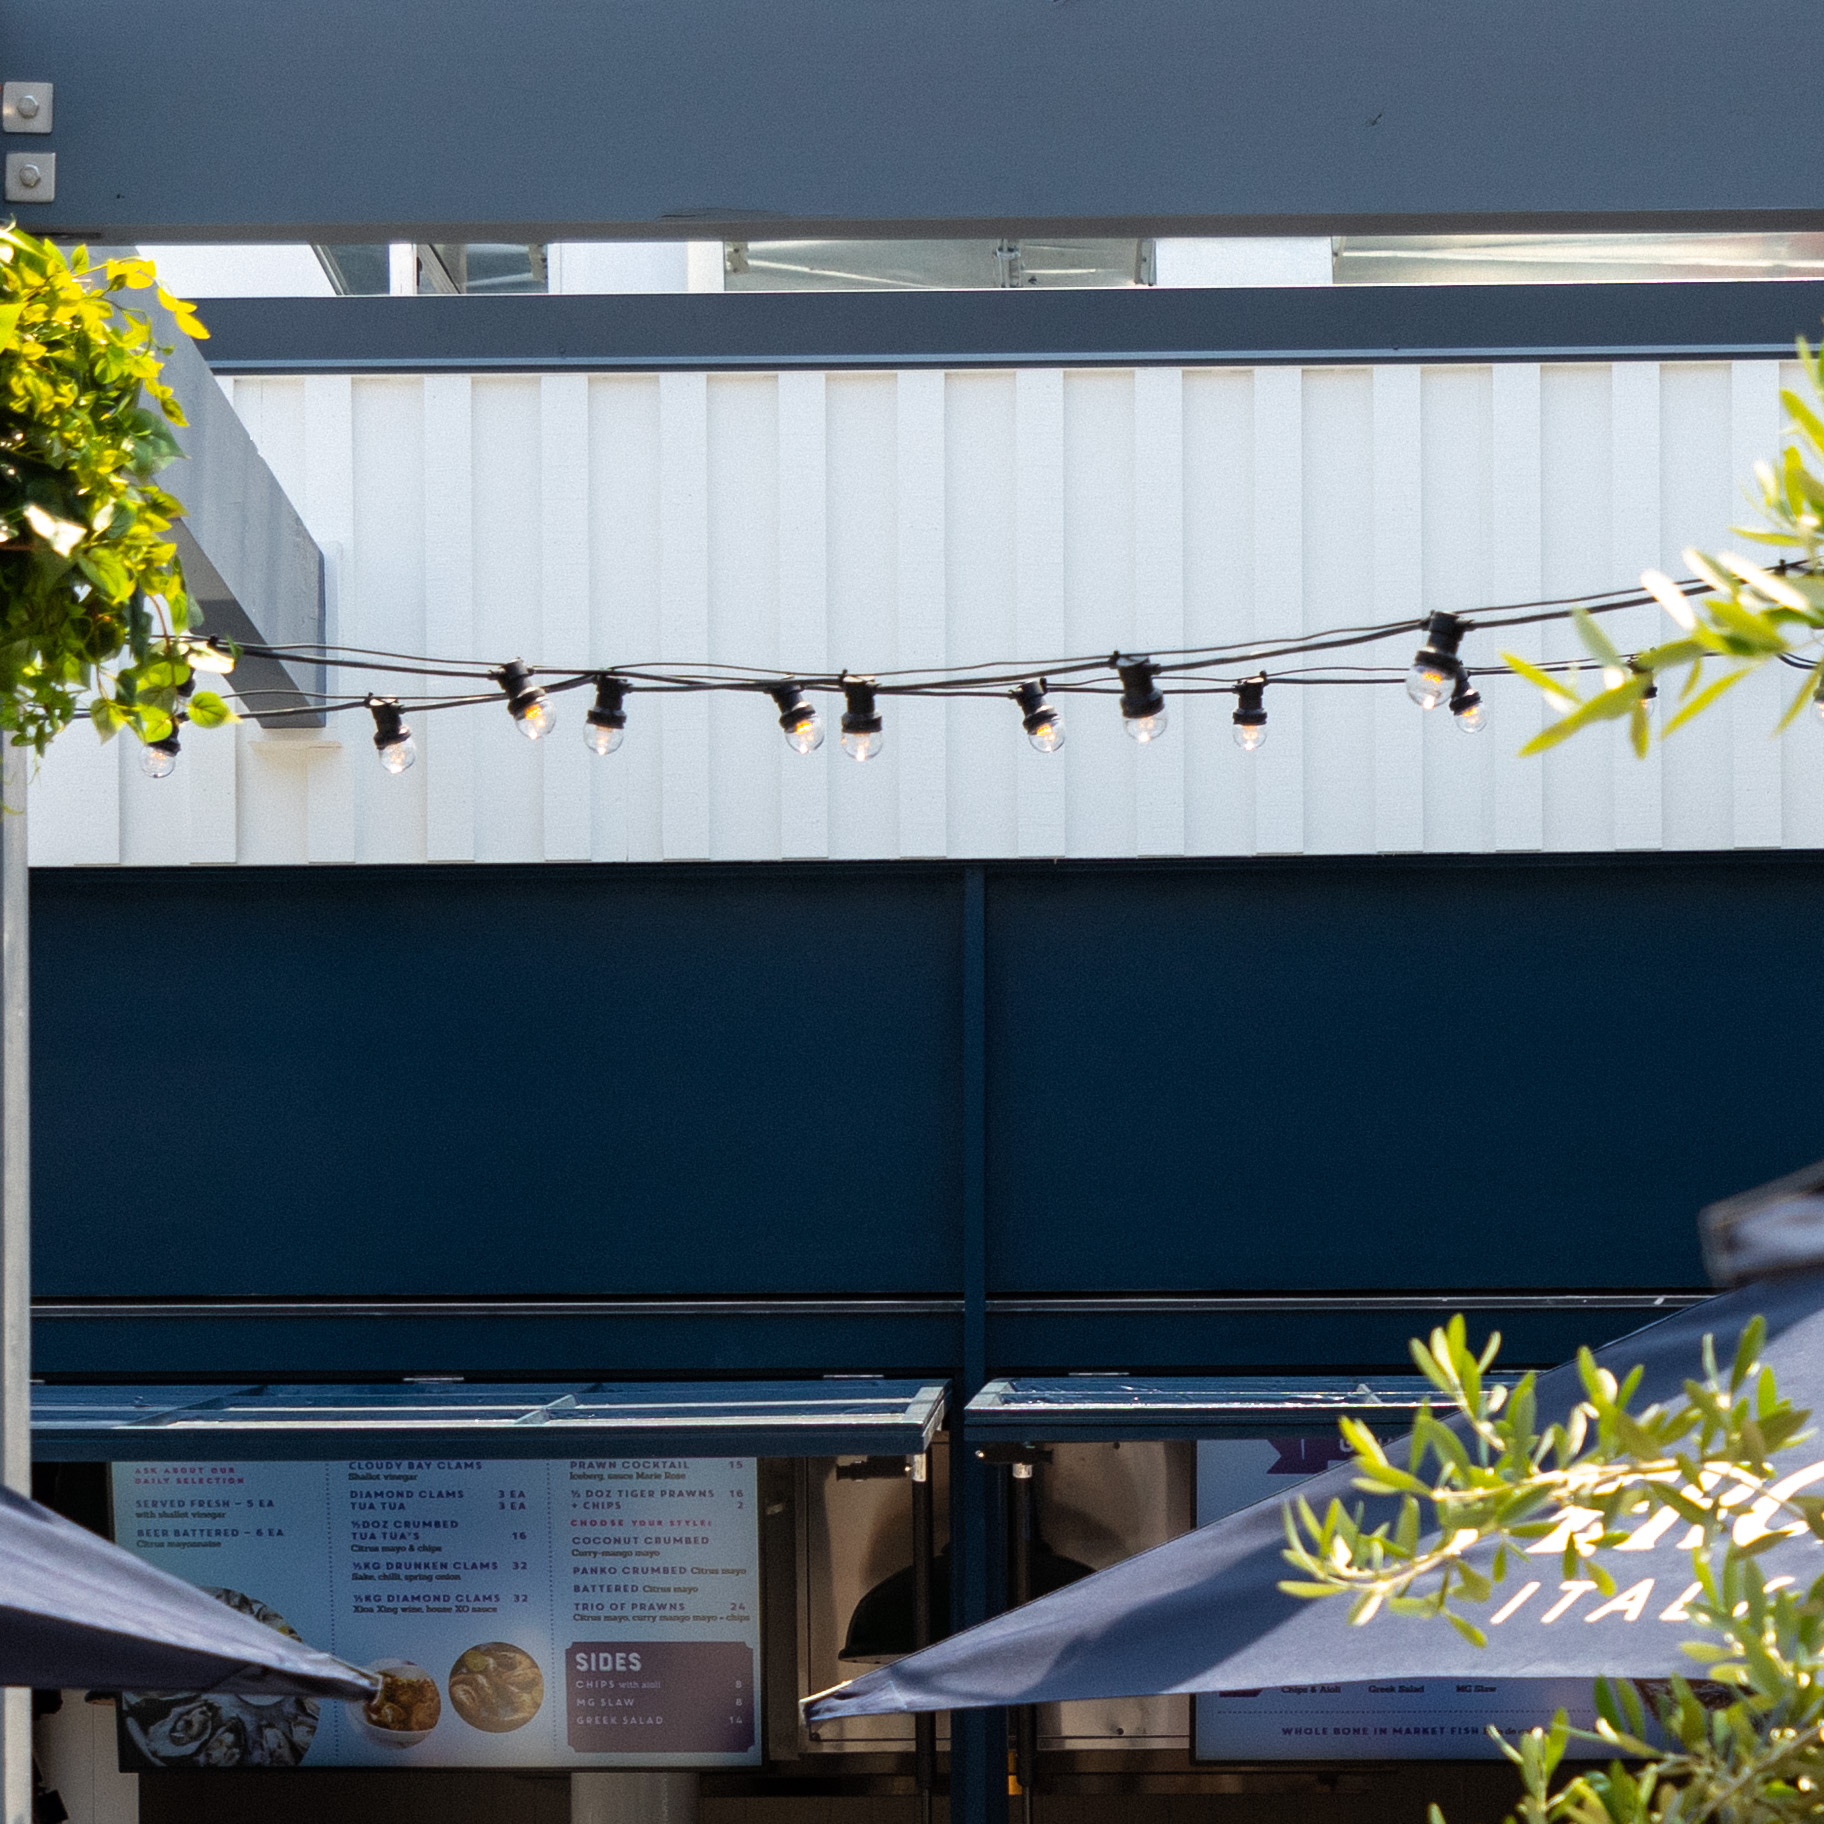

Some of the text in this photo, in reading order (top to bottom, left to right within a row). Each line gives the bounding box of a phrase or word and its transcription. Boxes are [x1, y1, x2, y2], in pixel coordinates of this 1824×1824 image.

[586, 1490, 612, 1498] DOZ
[618, 1490, 655, 1498] TIGER
[661, 1490, 713, 1498] PRAWNS
[730, 1490, 743, 1498] 16
[136, 1500, 185, 1508] SERVED
[191, 1500, 230, 1508] FRESH
[247, 1500, 253, 1508] 5
[259, 1500, 274, 1508] EA
[351, 1502, 525, 1510] TUA TUA 3 EA
[138, 1529, 168, 1537] BEER
[174, 1529, 239, 1537] BATTERED
[256, 1529, 263, 1537] 6
[269, 1529, 284, 1537] EA
[418, 1545, 442, 1553] chips
[722, 1568, 746, 1576] mayo
[405, 1574, 433, 1582] spring
[674, 1586, 698, 1594] mayo
[632, 1615, 656, 1623] curry
[659, 1615, 690, 1623] mango
[693, 1615, 717, 1623] mayo
[726, 1614, 750, 1622] chips
[576, 1653, 641, 1671] SIDES
[1281, 1685, 1307, 1694] Chips
[1320, 1685, 1341, 1694] Aioli
[1369, 1685, 1425, 1693] Greek Salad
[1456, 1685, 1472, 1693] MG
[1282, 1727, 1328, 1736] WHOLE
[1333, 1727, 1368, 1736] BONE
[1371, 1727, 1387, 1736] IN
[1393, 1727, 1445, 1736] MARKET
[1451, 1727, 1478, 1736] FISH
